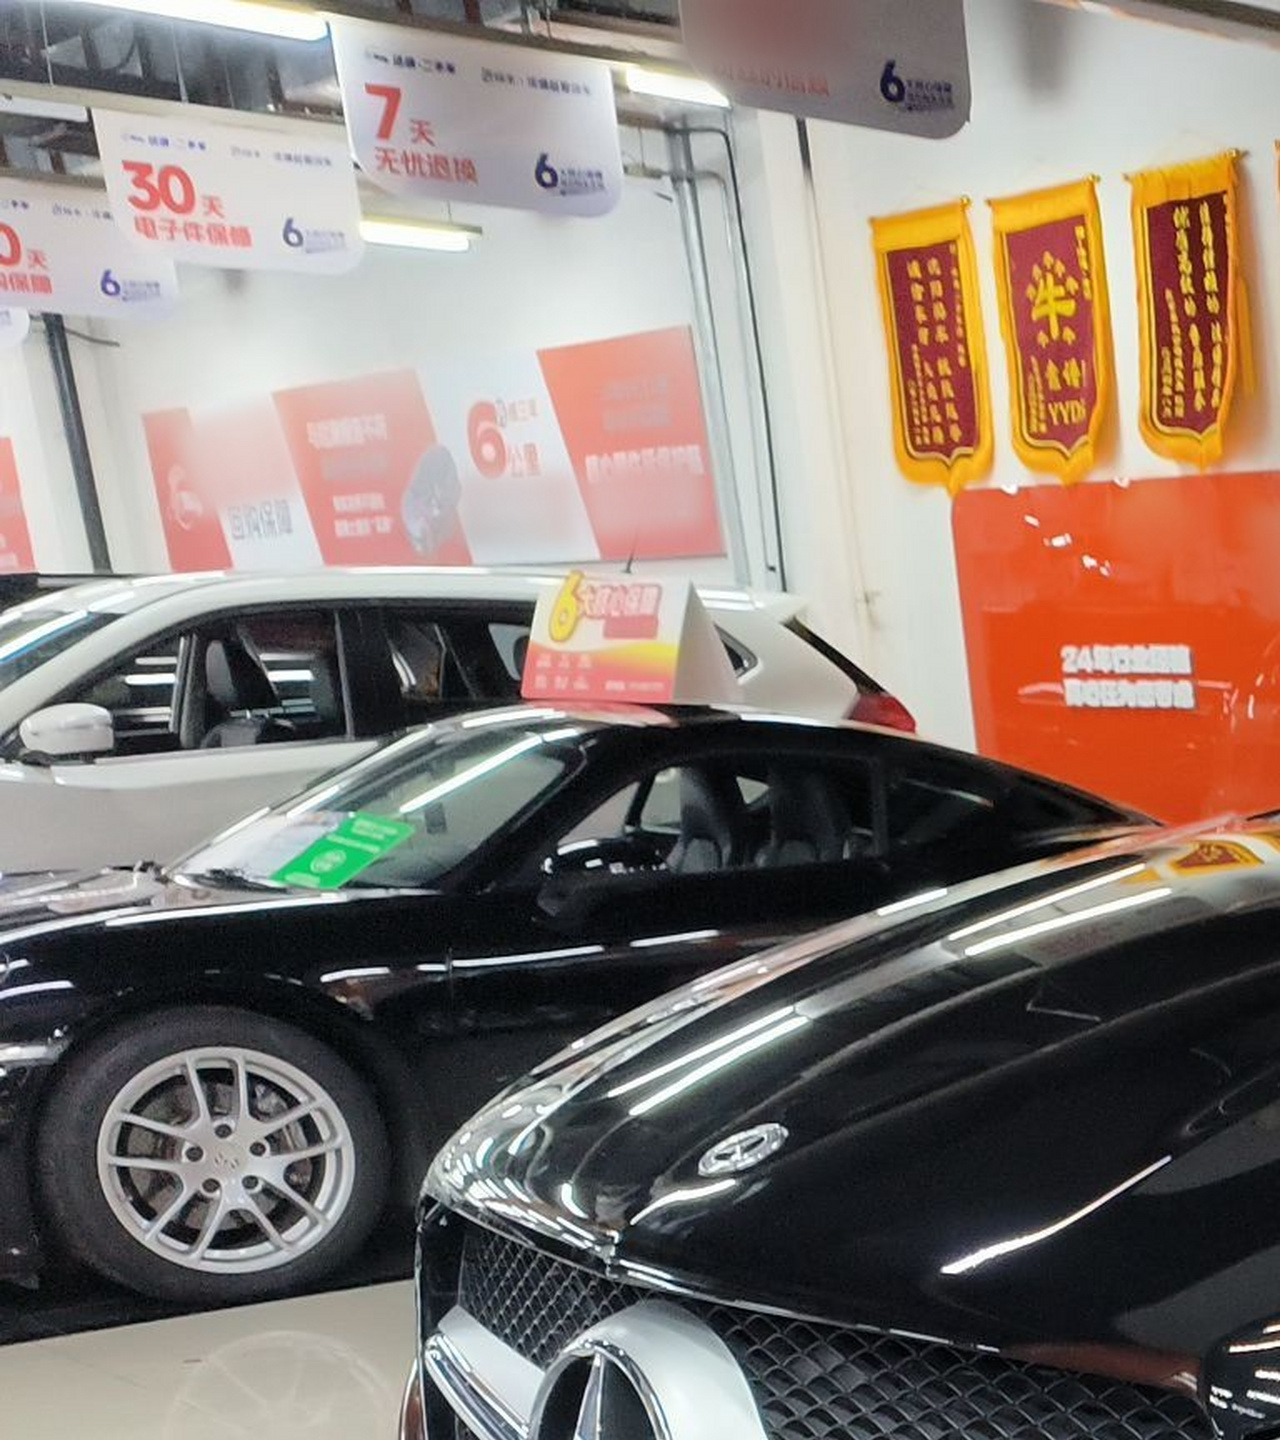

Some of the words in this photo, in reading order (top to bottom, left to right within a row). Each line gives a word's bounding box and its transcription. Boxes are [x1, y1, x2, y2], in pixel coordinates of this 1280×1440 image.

[880, 59, 905, 103] 6
[535, 152, 559, 190] 6
[282, 217, 304, 248] 6
[101, 269, 121, 297] 6
[1031, 271, 1076, 341] 牛
